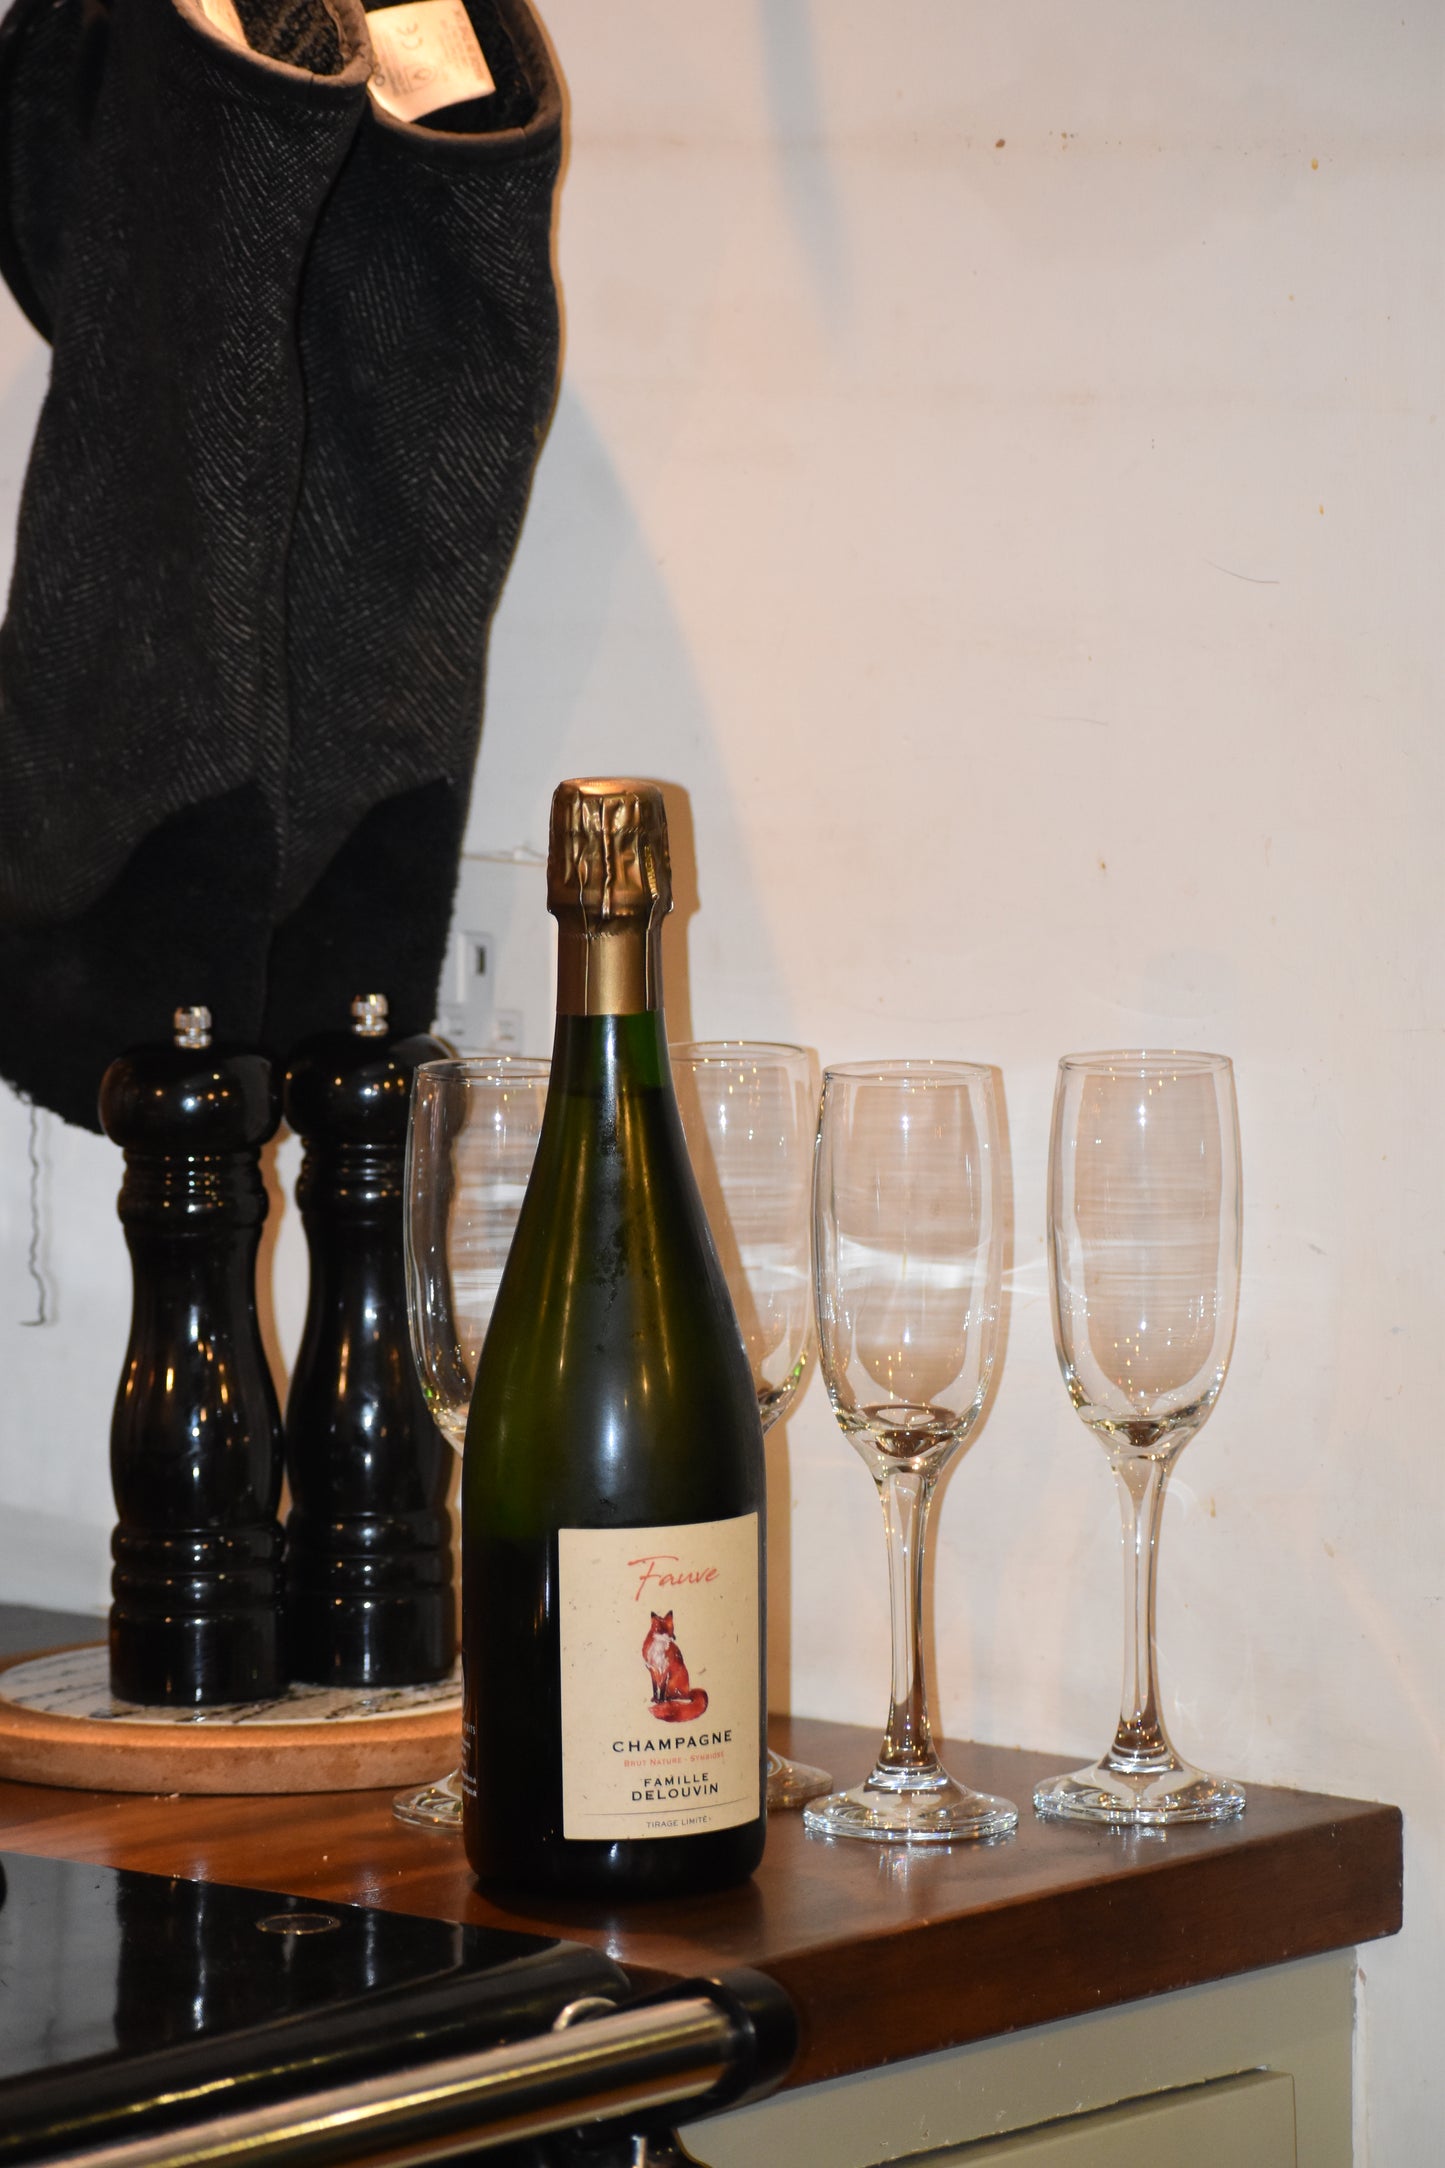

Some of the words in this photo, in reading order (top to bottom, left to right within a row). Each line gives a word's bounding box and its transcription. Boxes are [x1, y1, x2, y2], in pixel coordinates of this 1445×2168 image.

[627, 1555, 720, 1602] Fauve
[612, 1729, 733, 1753] CHAMPAGNE
[643, 1772, 709, 1788] FAMILLE
[631, 1782, 719, 1802] DELOUVIN
[646, 1819, 679, 1829] TIRAGE
